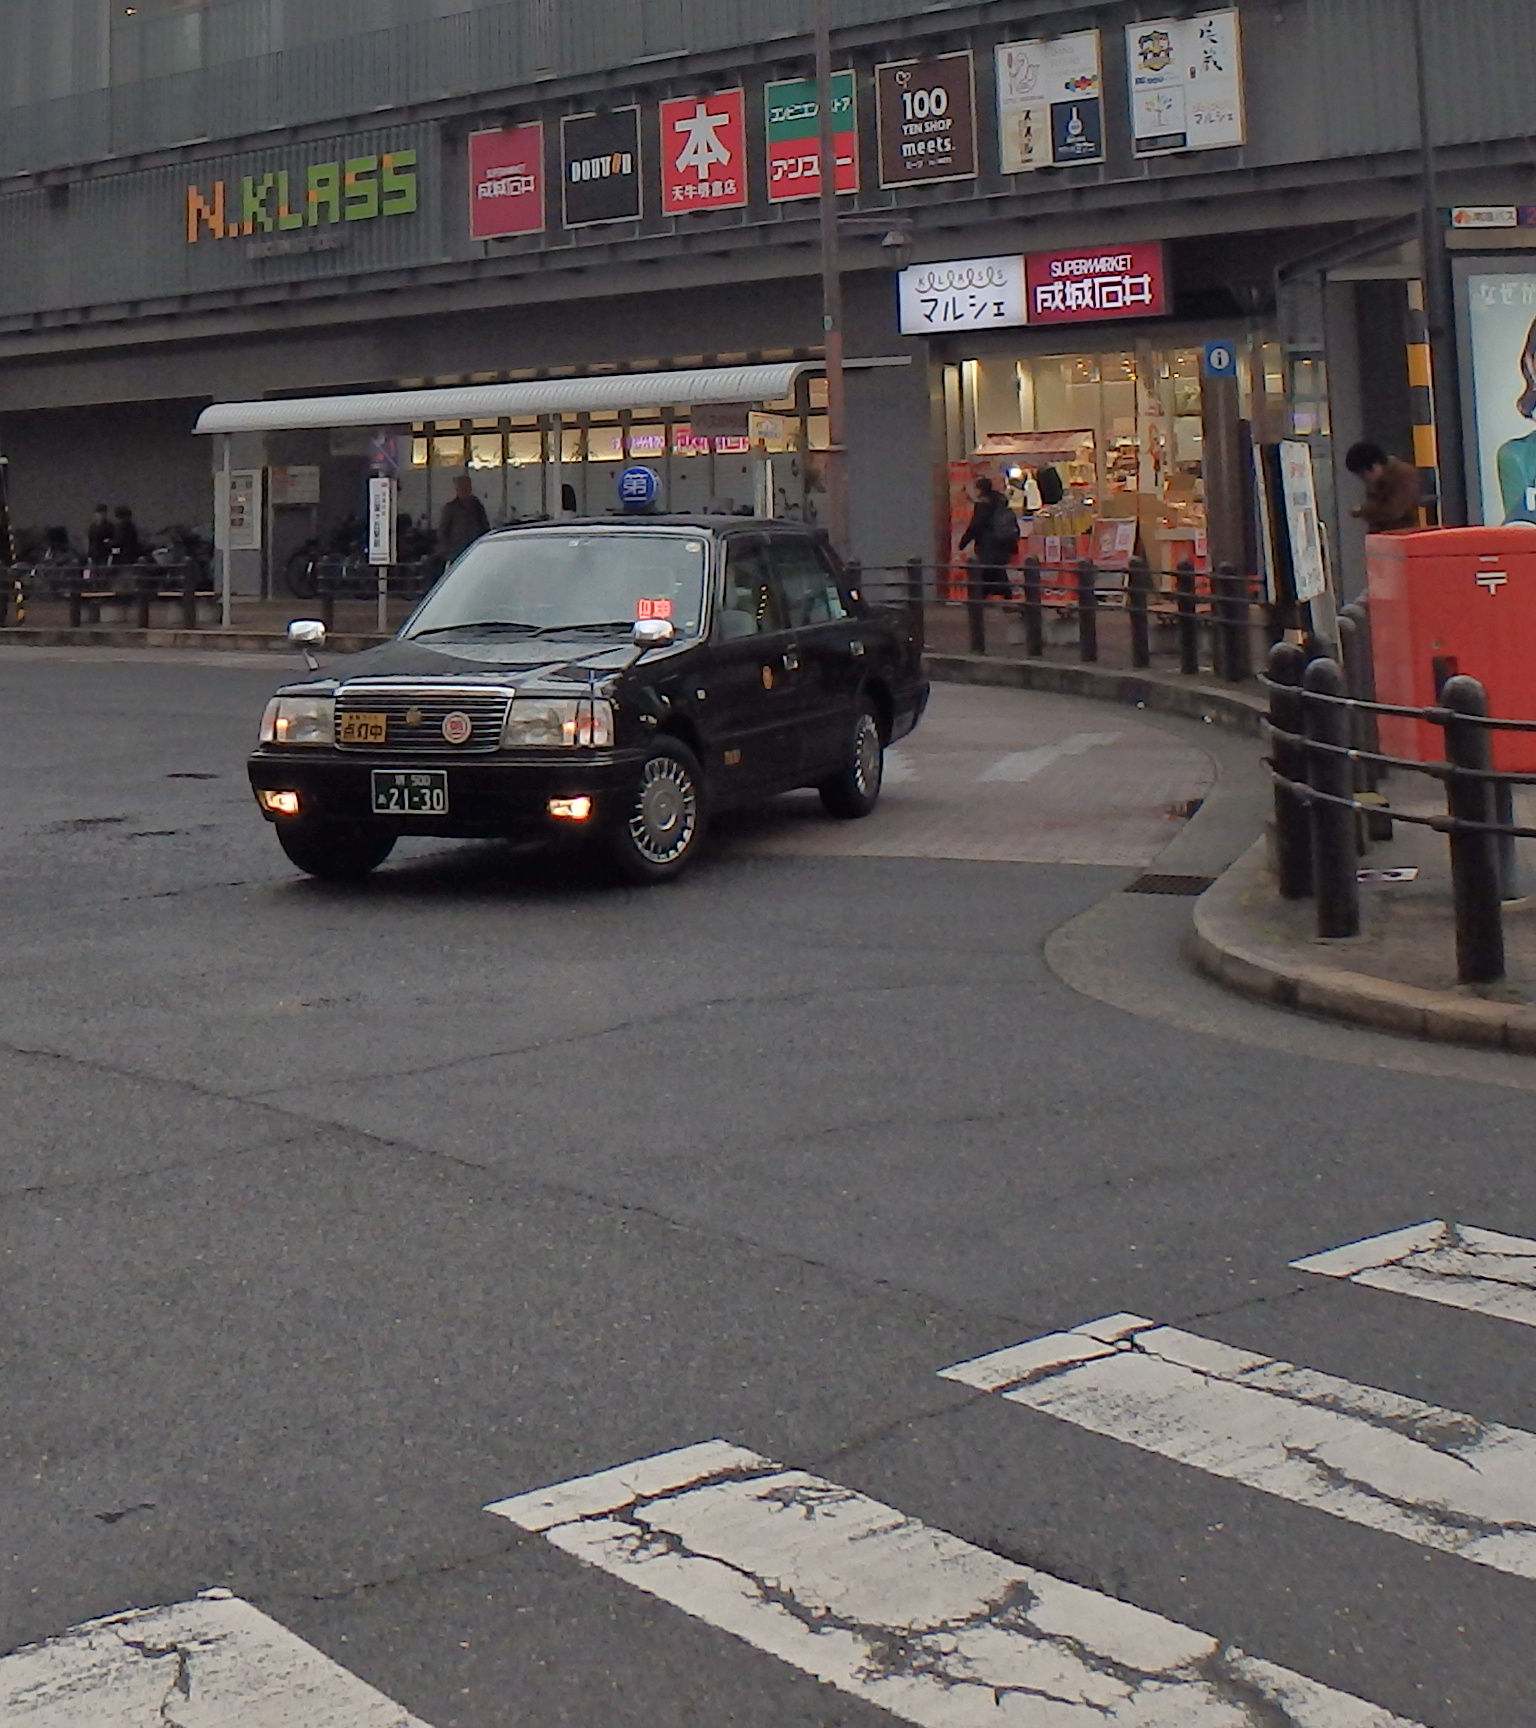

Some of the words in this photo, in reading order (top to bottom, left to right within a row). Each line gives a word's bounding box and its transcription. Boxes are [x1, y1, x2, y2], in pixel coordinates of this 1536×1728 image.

[902, 87, 948, 121] 100
[675, 103, 731, 180] 本
[902, 122, 923, 135] YEN
[924, 118, 953, 133] SHOP
[571, 152, 632, 183] DOUTOR
[187, 149, 417, 243] N.KLASS
[1050, 254, 1133, 278] SUPERMARKET
[920, 293, 1005, 323] マルシェ
[1036, 273, 1153, 314] 成城石井
[389, 787, 444, 811] 21-30
